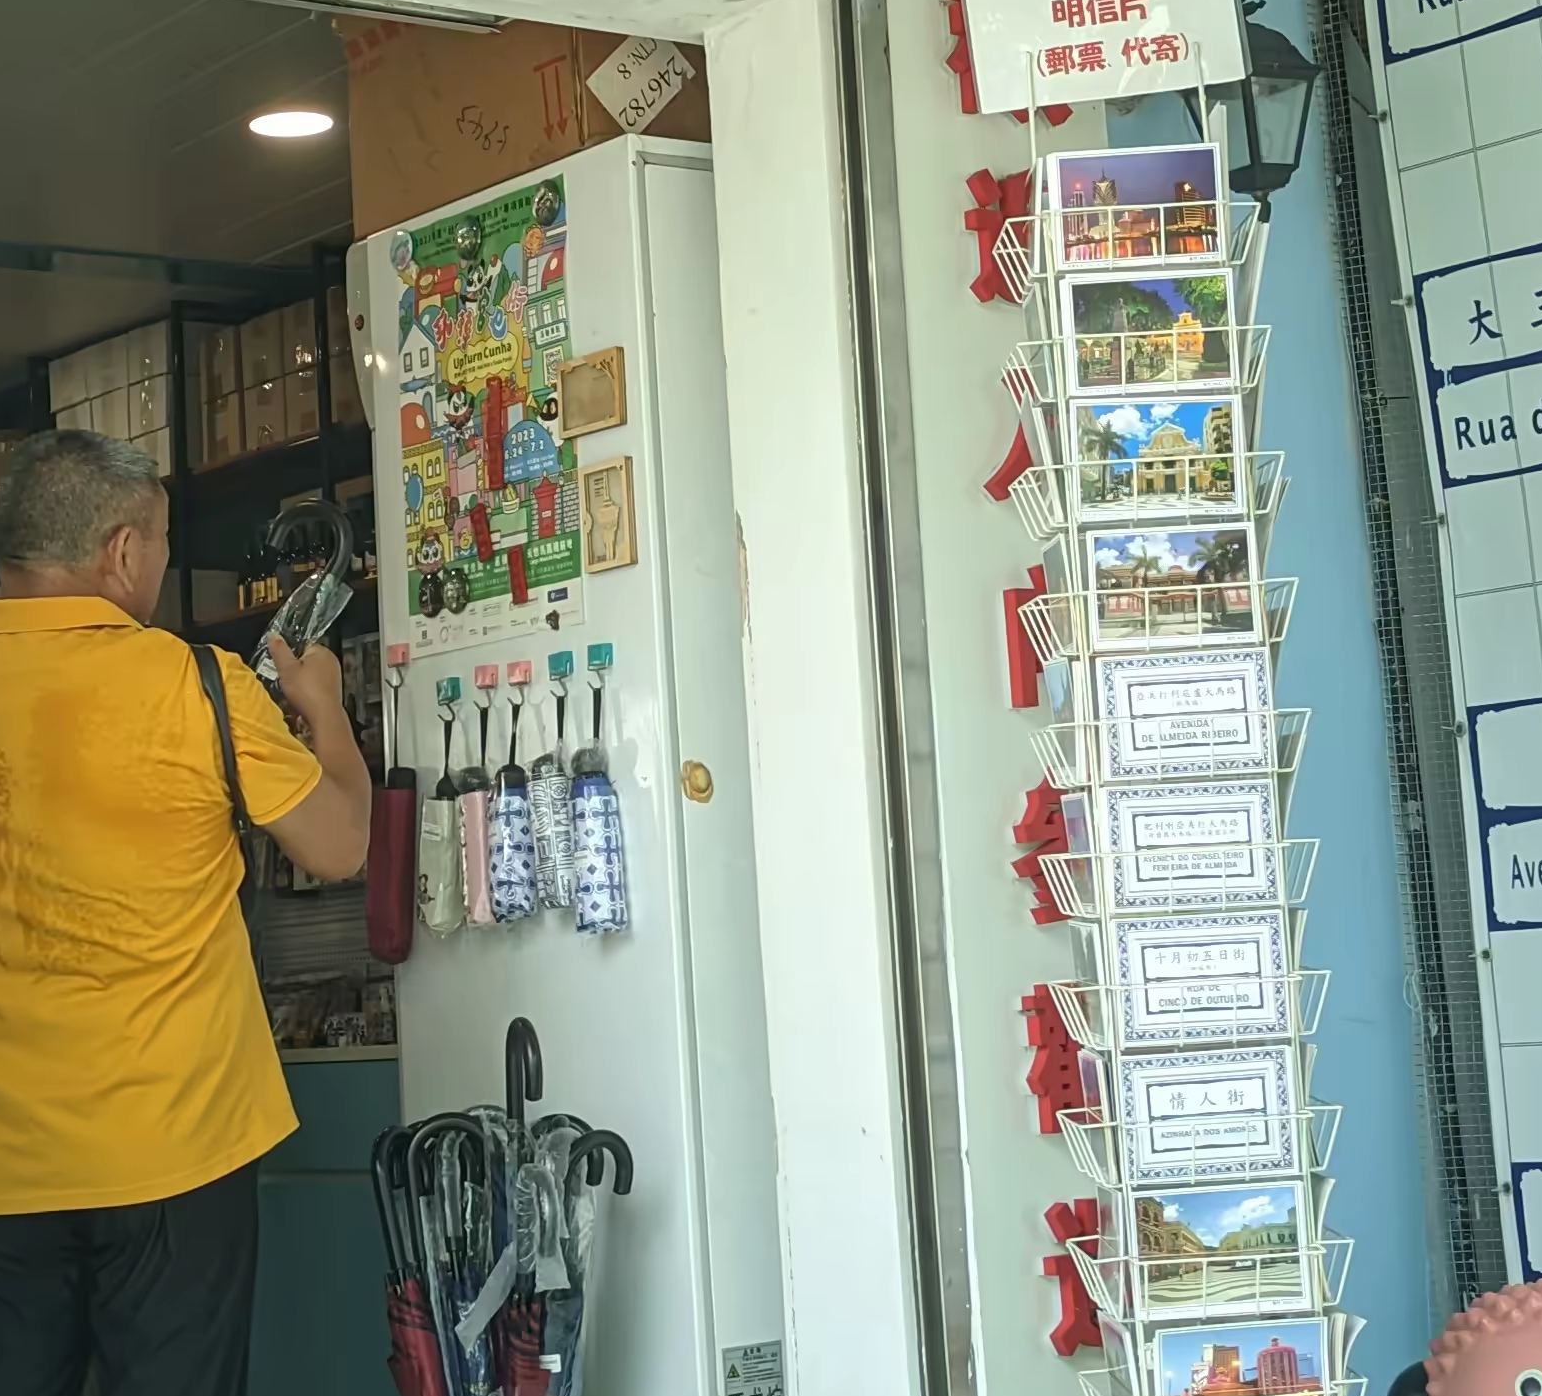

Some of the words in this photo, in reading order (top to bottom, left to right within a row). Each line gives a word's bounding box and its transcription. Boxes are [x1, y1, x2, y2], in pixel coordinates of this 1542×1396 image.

[618, 55, 685, 128] 246782
[483, 342, 512, 359] Cunha
[511, 427, 536, 445] 2023
[1454, 414, 1517, 450] Rua
[1169, 718, 1210, 729] AVENIDA
[1141, 734, 1154, 743] DE
[1178, 853, 1190, 862] DO
[1191, 862, 1202, 870] DE
[1155, 948, 1246, 965] 十月初五日街
[1191, 996, 1204, 1005] DE
[1169, 1089, 1245, 1111] 情人街
[1203, 1128, 1221, 1136] DOS
